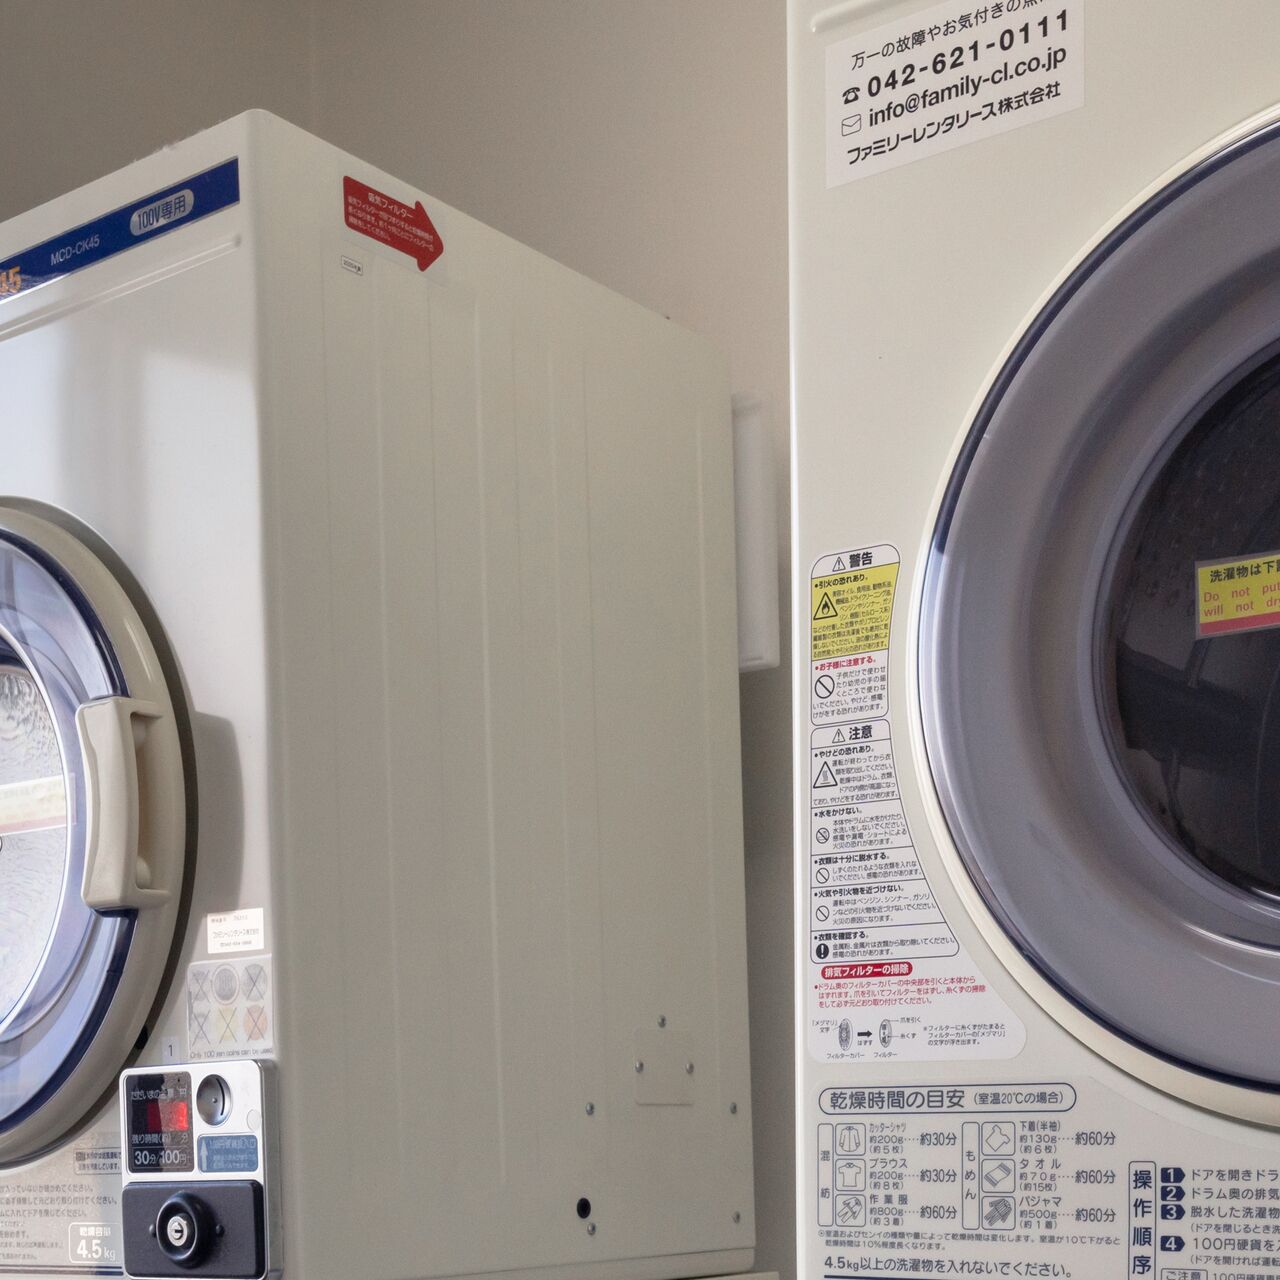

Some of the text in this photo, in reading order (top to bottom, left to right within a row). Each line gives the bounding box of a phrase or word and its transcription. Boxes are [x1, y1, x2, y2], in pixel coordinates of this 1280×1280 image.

[852, 0, 1042, 70] 万一の故障やお気付きの点
[867, 9, 1067, 97] 042-621-0111
[870, 47, 1066, 127] info@family-cl.co.jp
[848, 81, 1061, 165] ファミリーレンタリース株式会社
[51, 235, 100, 266] MCD-CK45
[136, 195, 186, 231] 100V専用
[849, 552, 873, 568] 警告
[819, 574, 868, 589] 引火の恐れあり。
[1204, 592, 1219, 602] Do
[1231, 587, 1250, 598] not
[1262, 583, 1280, 594] put
[1204, 605, 1223, 617] will
[1235, 601, 1254, 612] not
[849, 725, 872, 740] 注意
[819, 745, 873, 758] やけどの恐れあり。
[819, 807, 862, 818] 水をかけない。
[819, 885, 903, 898] 火気や引火物を近づけない。
[819, 931, 868, 941] 衣類を確認する。
[825, 964, 909, 977] 排気フィルターの掃除
[168, 1044, 173, 1056] 1
[831, 1090, 965, 1110] 乾燥時間の目安
[920, 1132, 957, 1146] 約30分
[1075, 1132, 1116, 1146] 約60分
[870, 1158, 908, 1169] ブラウス
[920, 1169, 957, 1183] 約30分
[1075, 1169, 1116, 1184] 約60分
[1020, 1196, 1061, 1208] パジャマ
[920, 1206, 957, 1219] 約60分
[1075, 1207, 1116, 1223] 約60分
[1133, 1170, 1152, 1274] 操作順序
[824, 1257, 1072, 1278] 4.5kg以上の洗濯物を入れないでください。
